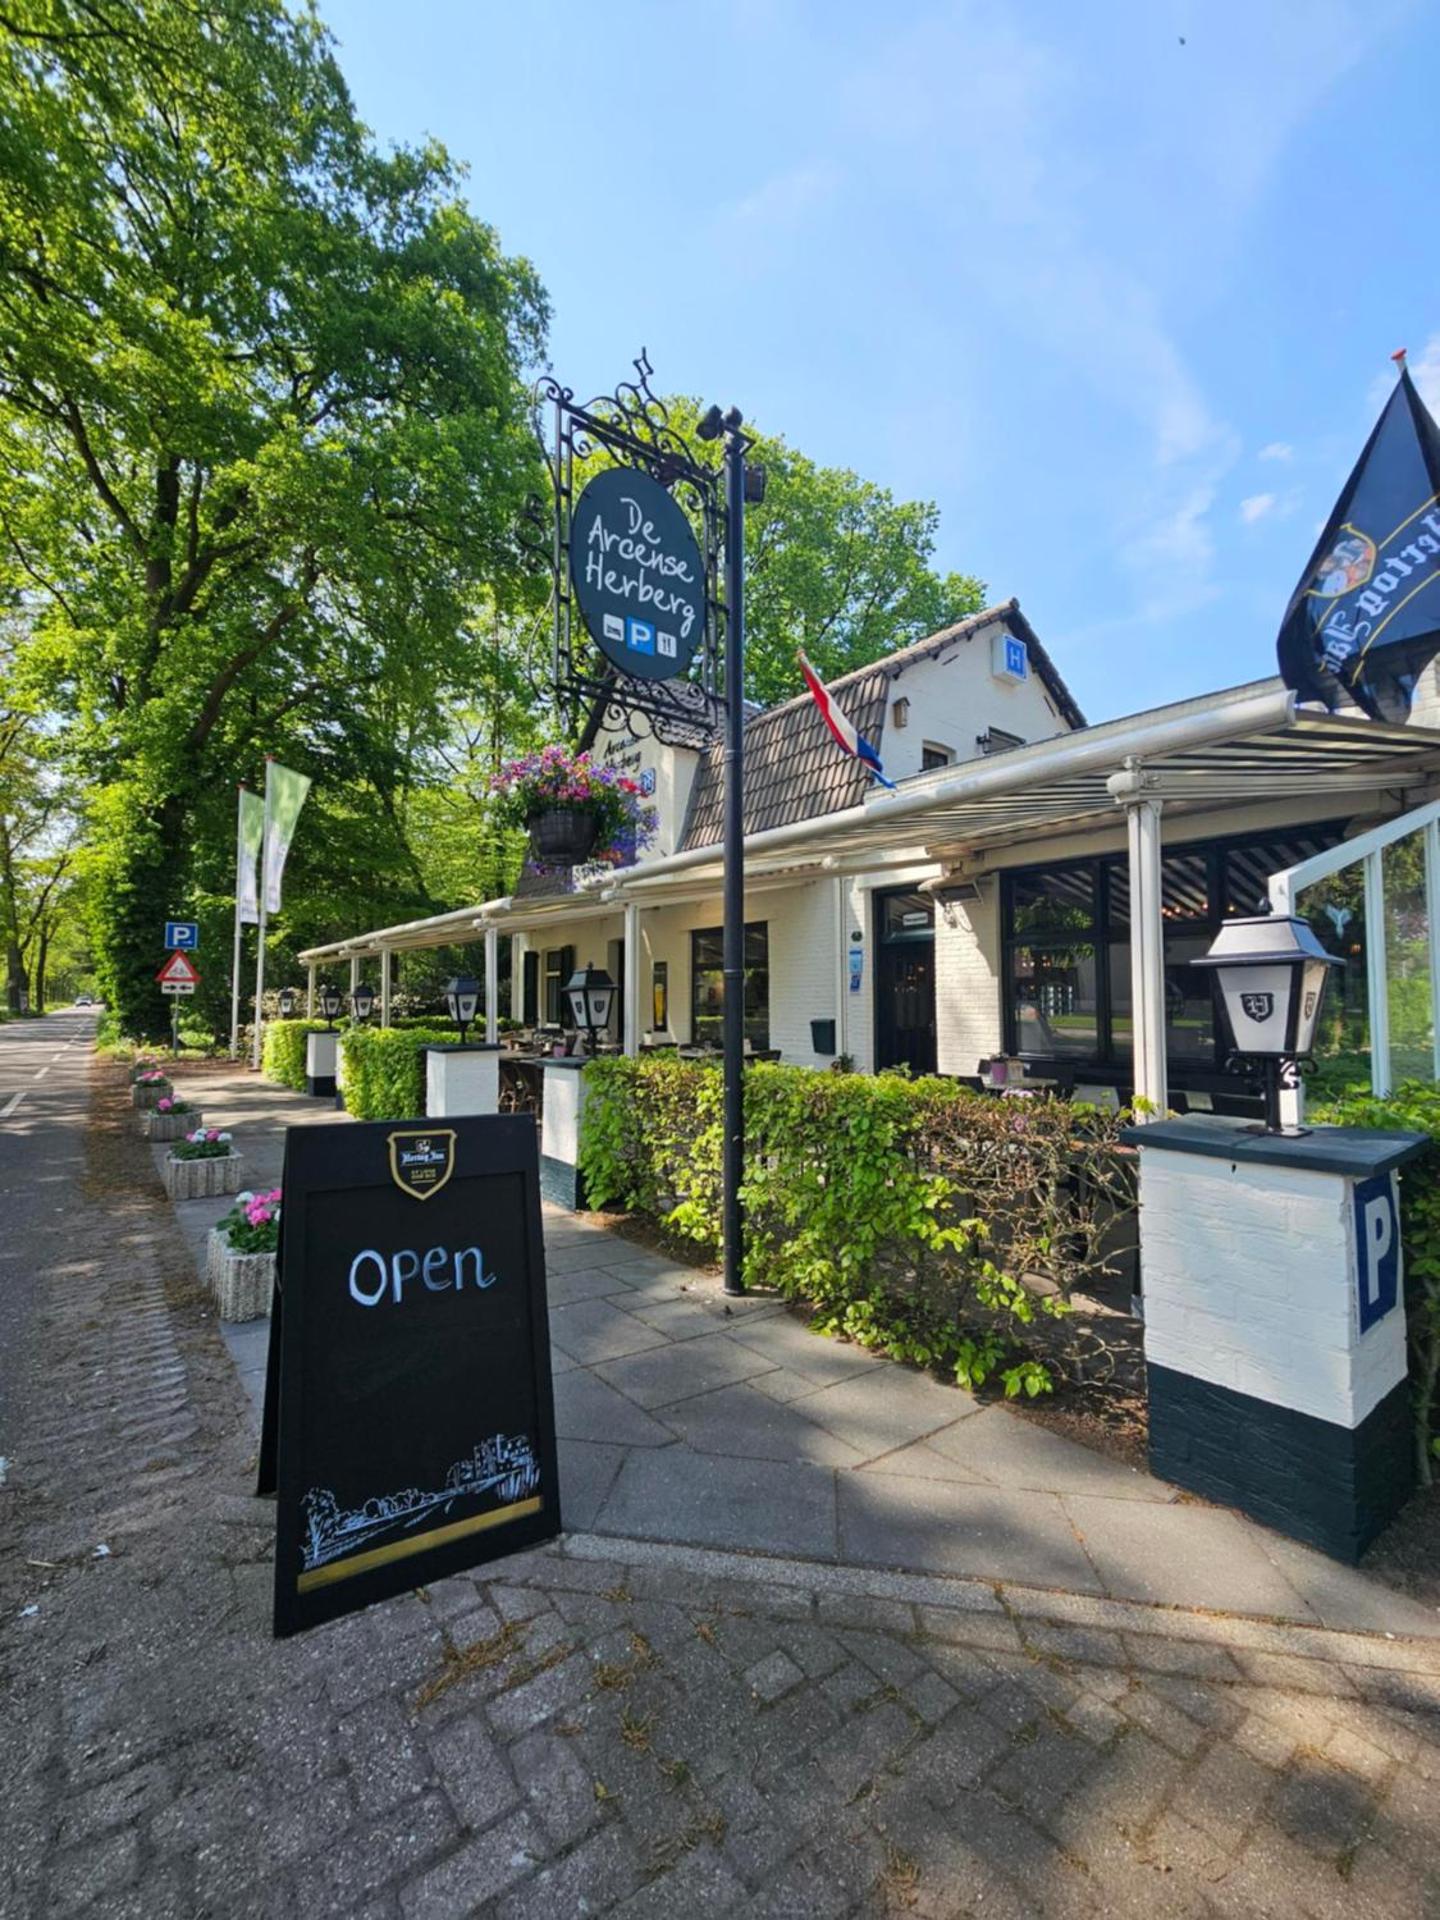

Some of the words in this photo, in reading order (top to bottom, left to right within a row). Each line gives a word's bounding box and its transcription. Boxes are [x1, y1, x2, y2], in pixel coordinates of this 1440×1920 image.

[620, 498, 661, 544] De
[587, 514, 694, 583] Arcense
[585, 551, 696, 638] Herberg
[630, 624, 652, 646] P
[1009, 644, 1022, 670] H
[173, 926, 190, 946] P
[1363, 1194, 1392, 1305] P
